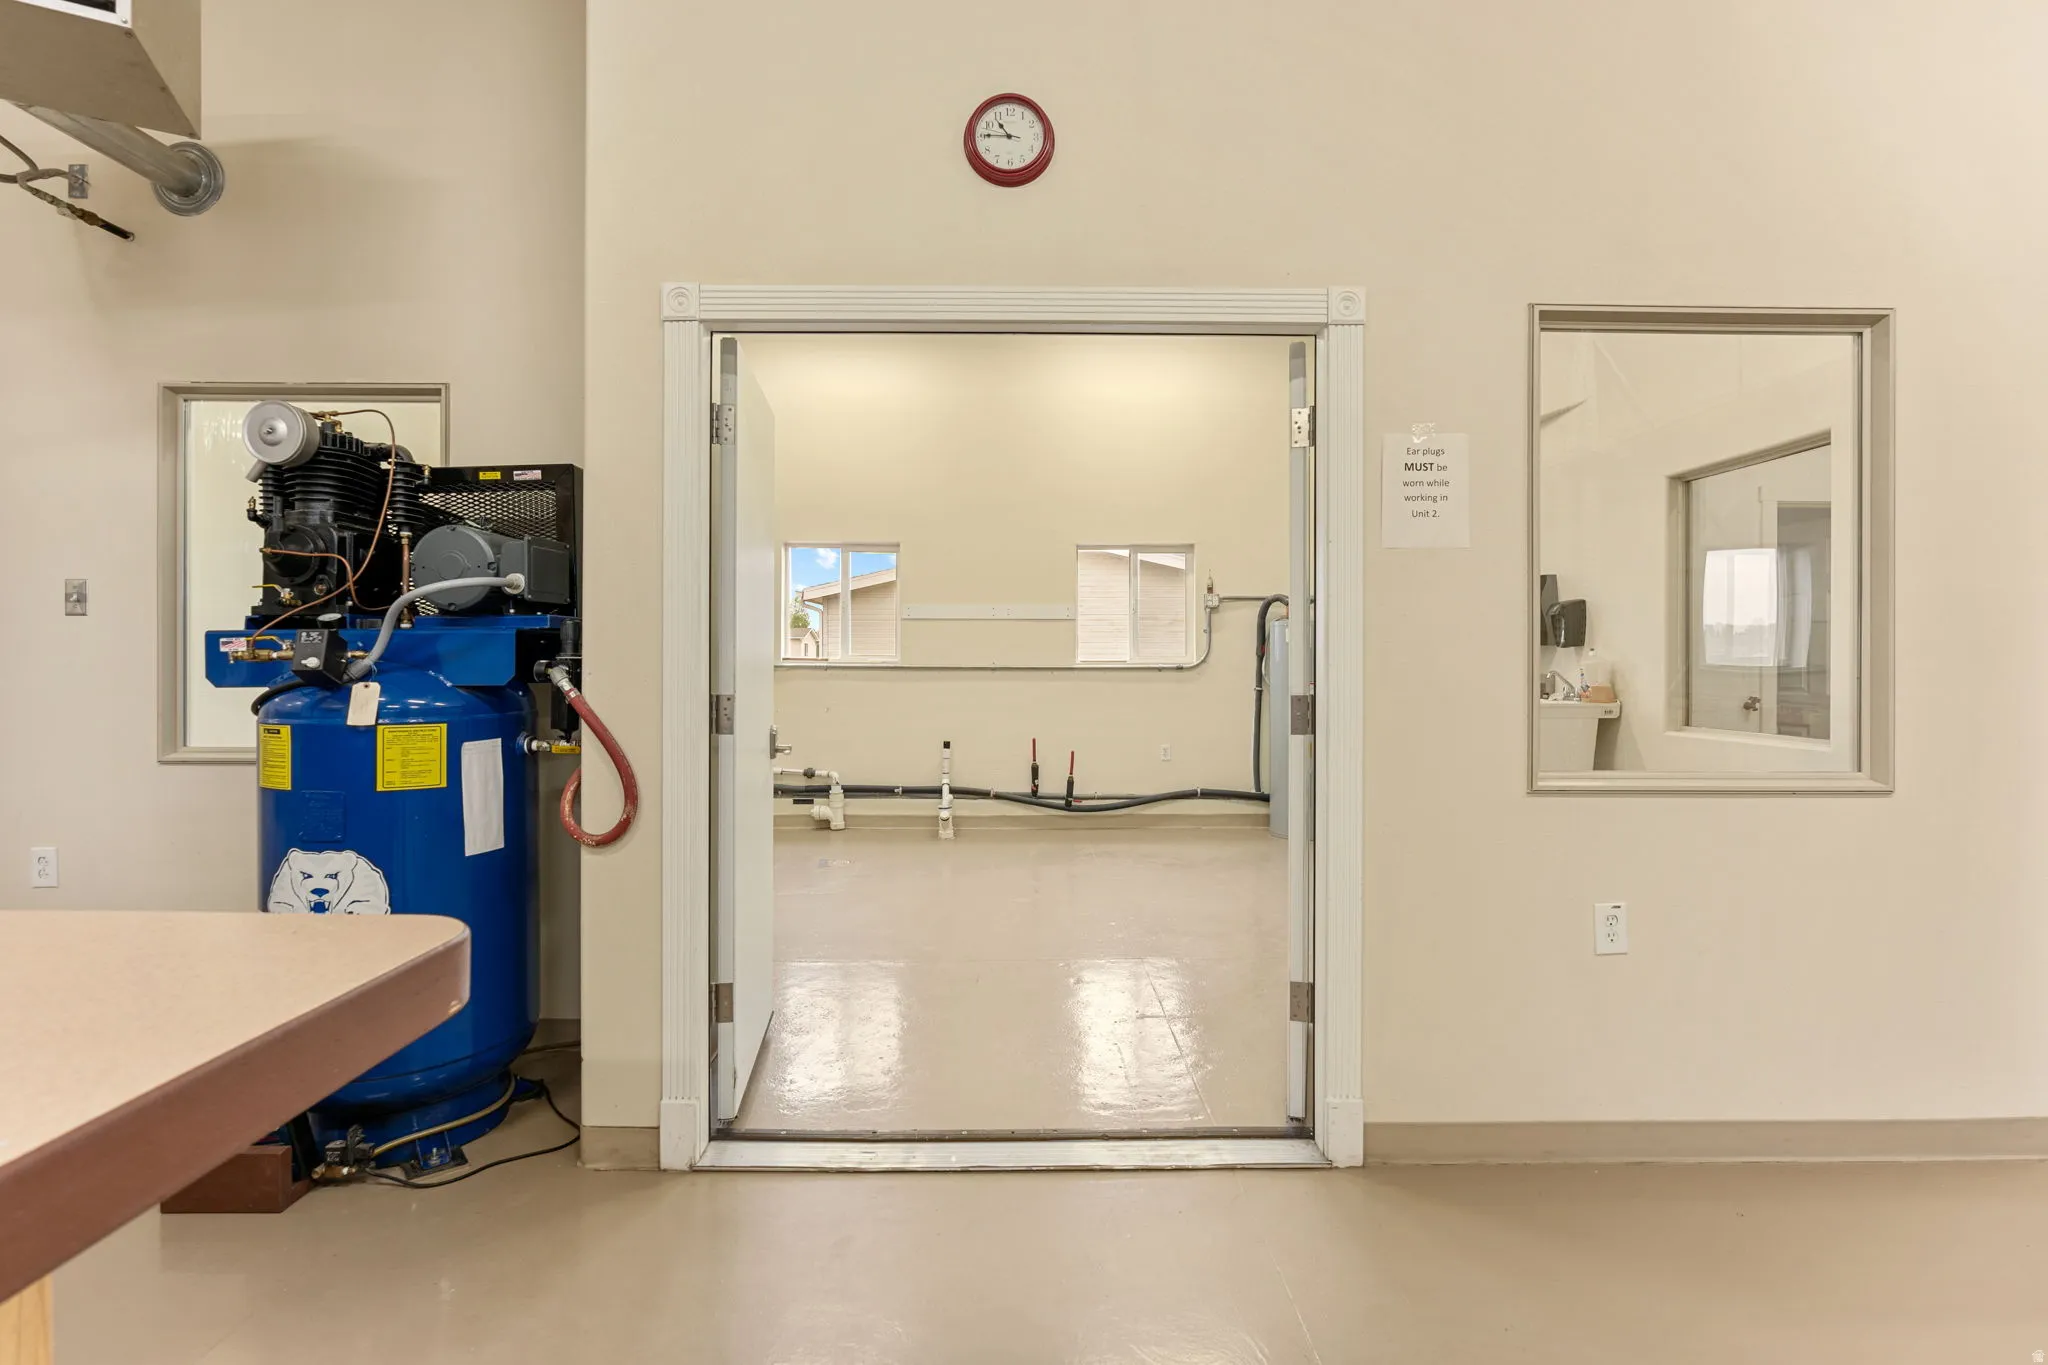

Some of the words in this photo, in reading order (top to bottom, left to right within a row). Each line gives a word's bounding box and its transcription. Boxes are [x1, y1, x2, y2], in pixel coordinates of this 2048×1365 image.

[1006, 107, 1016, 117] 12
[985, 120, 994, 129] 10
[1028, 120, 1035, 129] 2
[1406, 447, 1420, 456] Ear
[1422, 447, 1445, 457] plugs
[1404, 462, 1434, 472] MUST
[1437, 464, 1448, 472] be
[1426, 479, 1450, 487] while
[1403, 493, 1438, 503] working
[1440, 493, 1448, 502] in
[1411, 509, 1430, 518] Unit
[1432, 509, 1440, 518] 2.
